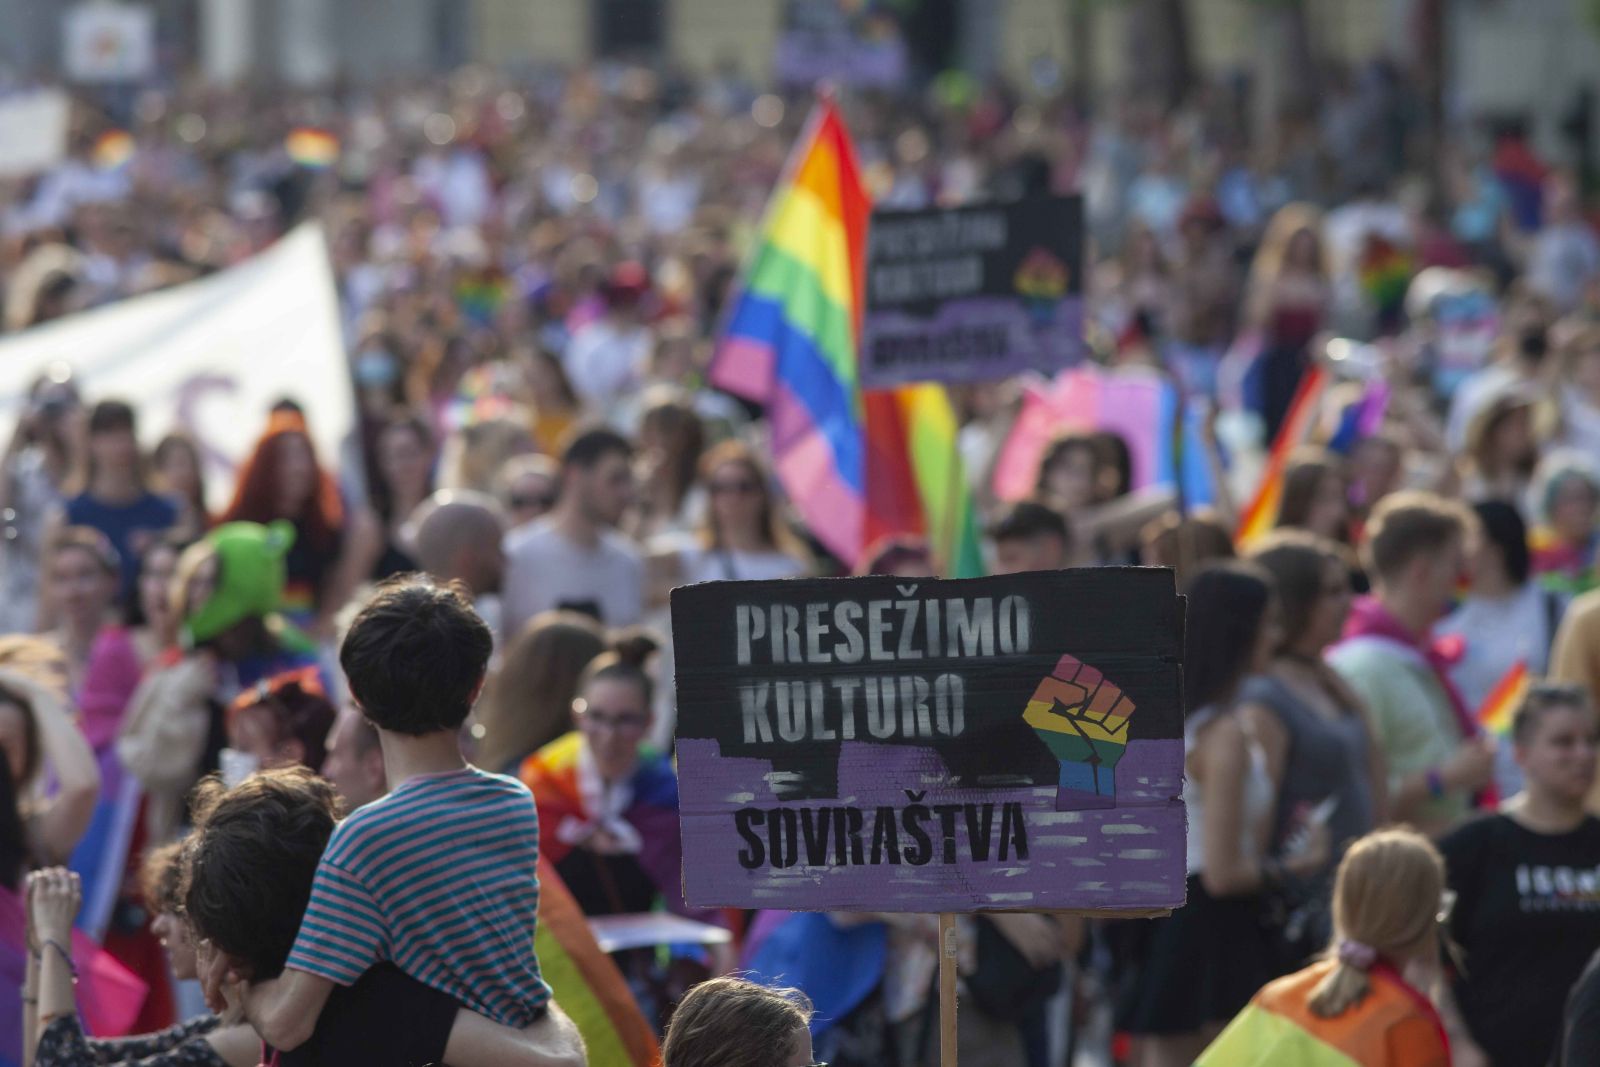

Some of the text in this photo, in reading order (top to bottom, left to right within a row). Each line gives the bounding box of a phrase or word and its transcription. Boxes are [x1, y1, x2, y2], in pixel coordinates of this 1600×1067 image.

[735, 585, 1031, 665] PRESEŽIMO
[740, 673, 966, 744] KULTURO
[735, 789, 1029, 869] SOVRAŠTVA
